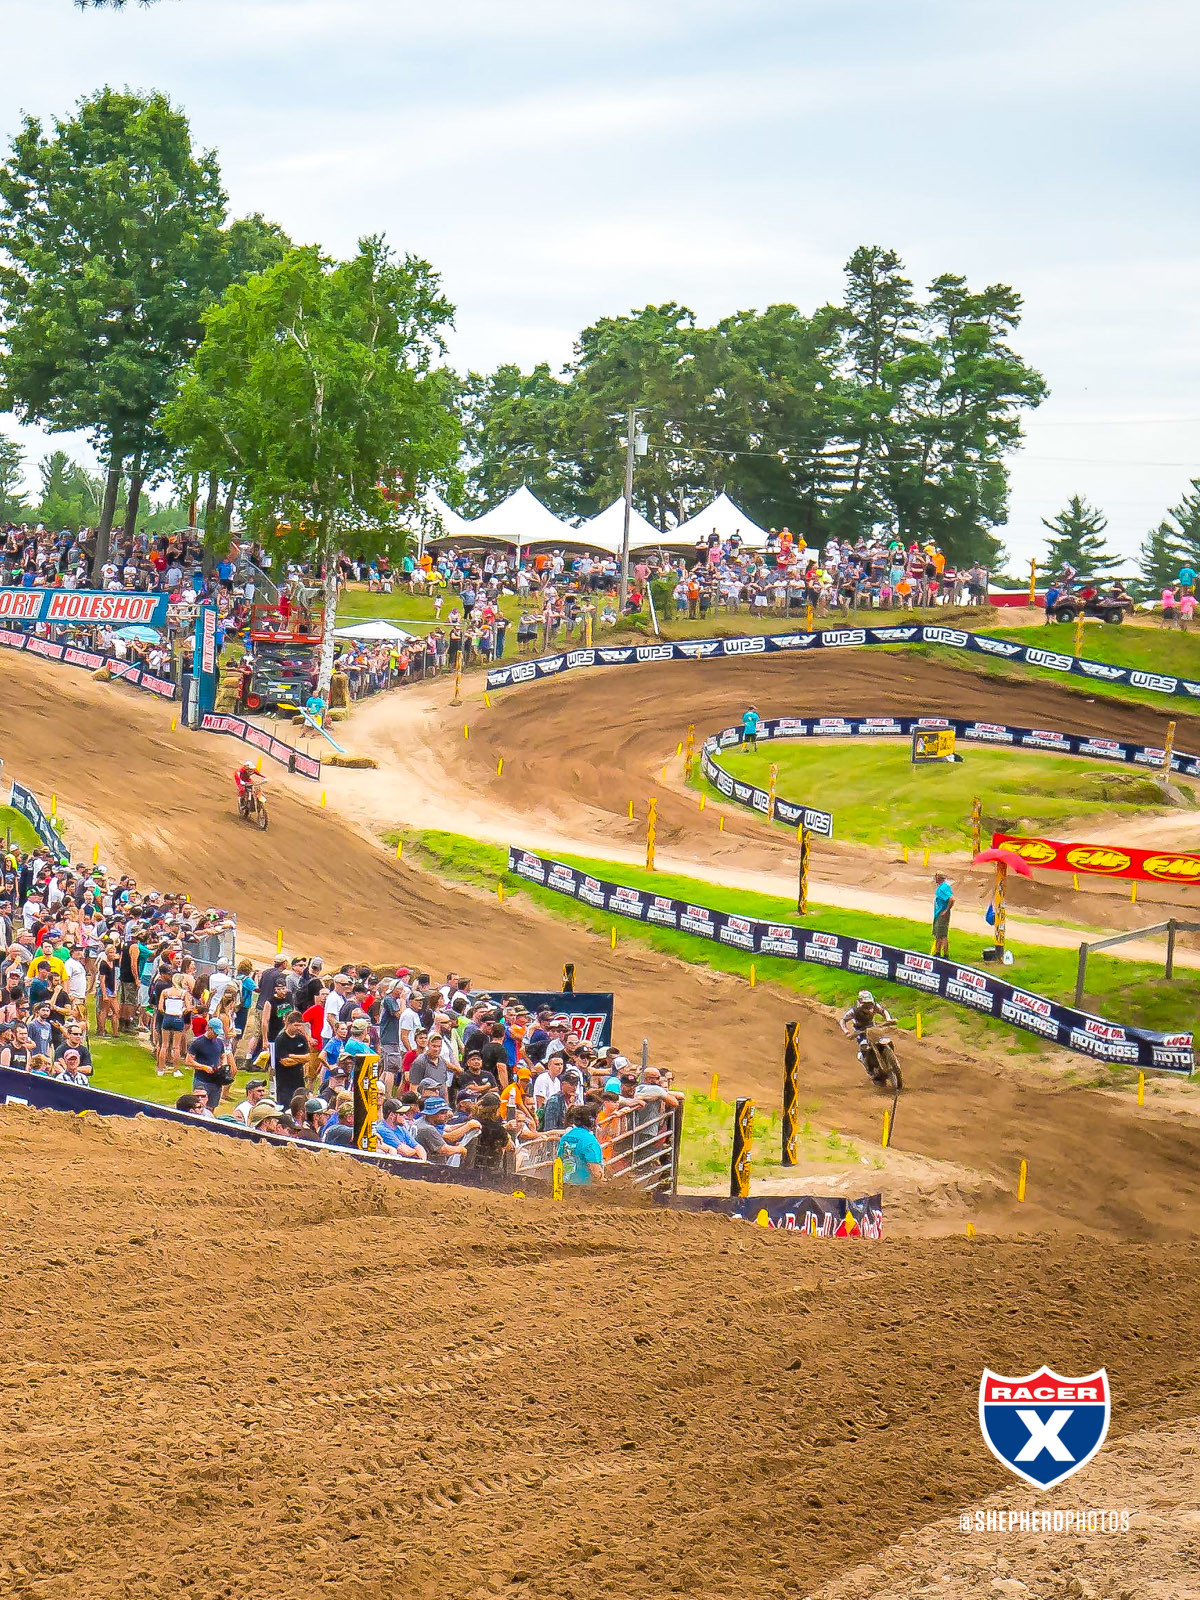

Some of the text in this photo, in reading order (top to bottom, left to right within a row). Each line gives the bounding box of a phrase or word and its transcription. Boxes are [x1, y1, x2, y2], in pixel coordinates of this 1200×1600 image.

[49, 591, 160, 622] HOLESHOT
[511, 663, 536, 683] WPS
[567, 650, 595, 668] WPS
[636, 645, 673, 661] WPS
[723, 637, 766, 655] WPS
[822, 629, 866, 646] WPS
[922, 627, 968, 647] WPS
[1026, 648, 1073, 672] WPS
[1130, 671, 1178, 693] WPS
[804, 809, 830, 834] WPS
[1067, 850, 1130, 868] FMF
[1014, 992, 1036, 1011] LUCAS
[1111, 1027, 1124, 1040] OIL
